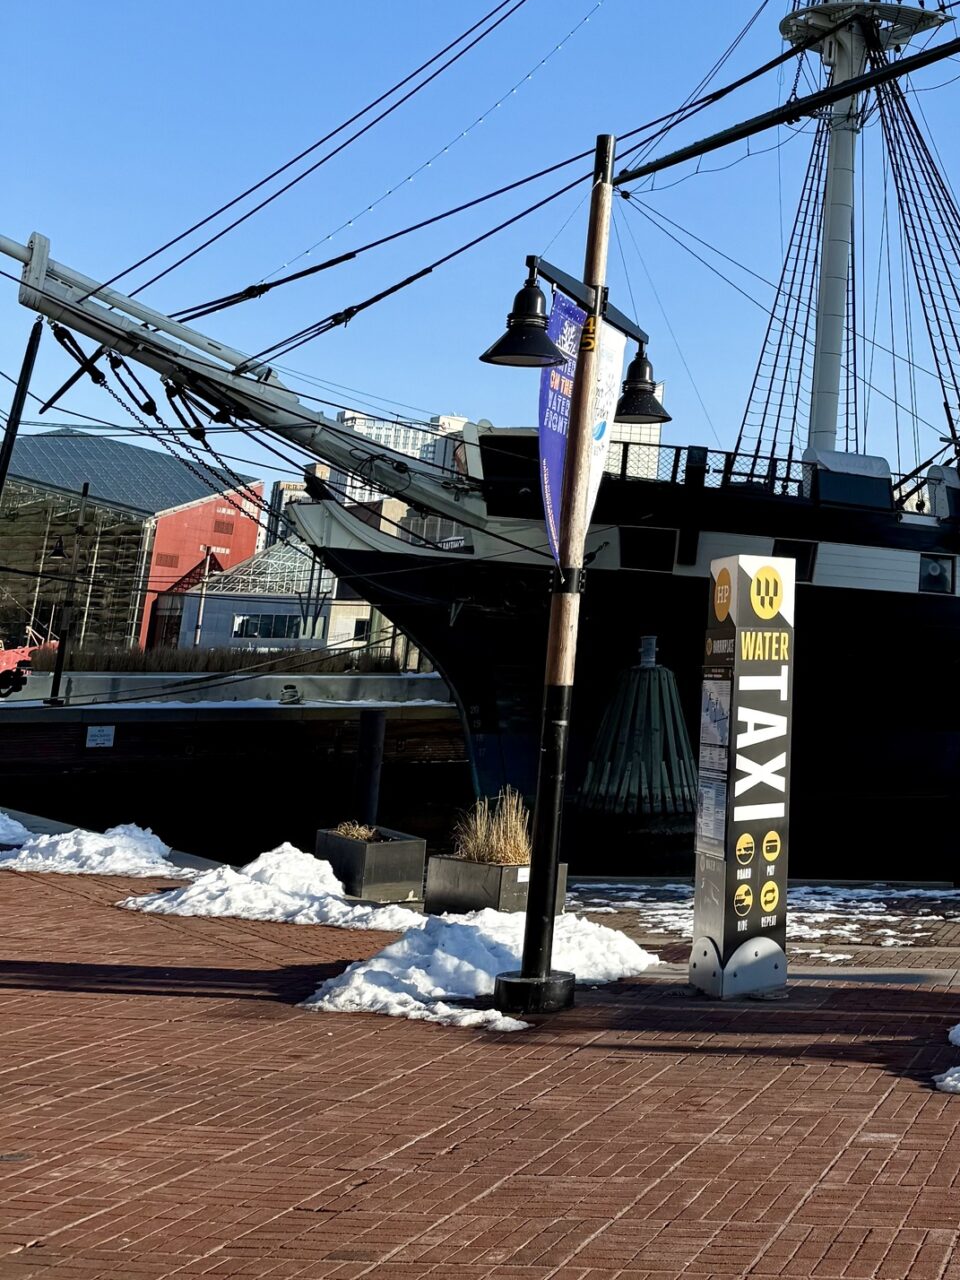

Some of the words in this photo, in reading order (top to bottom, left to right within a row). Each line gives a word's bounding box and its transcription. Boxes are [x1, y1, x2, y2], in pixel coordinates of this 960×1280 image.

[550, 369, 561, 391] ON
[560, 376, 574, 398] THE
[716, 585, 730, 604] HP
[741, 631, 789, 661] WATER
[733, 665, 789, 822] TAXI
